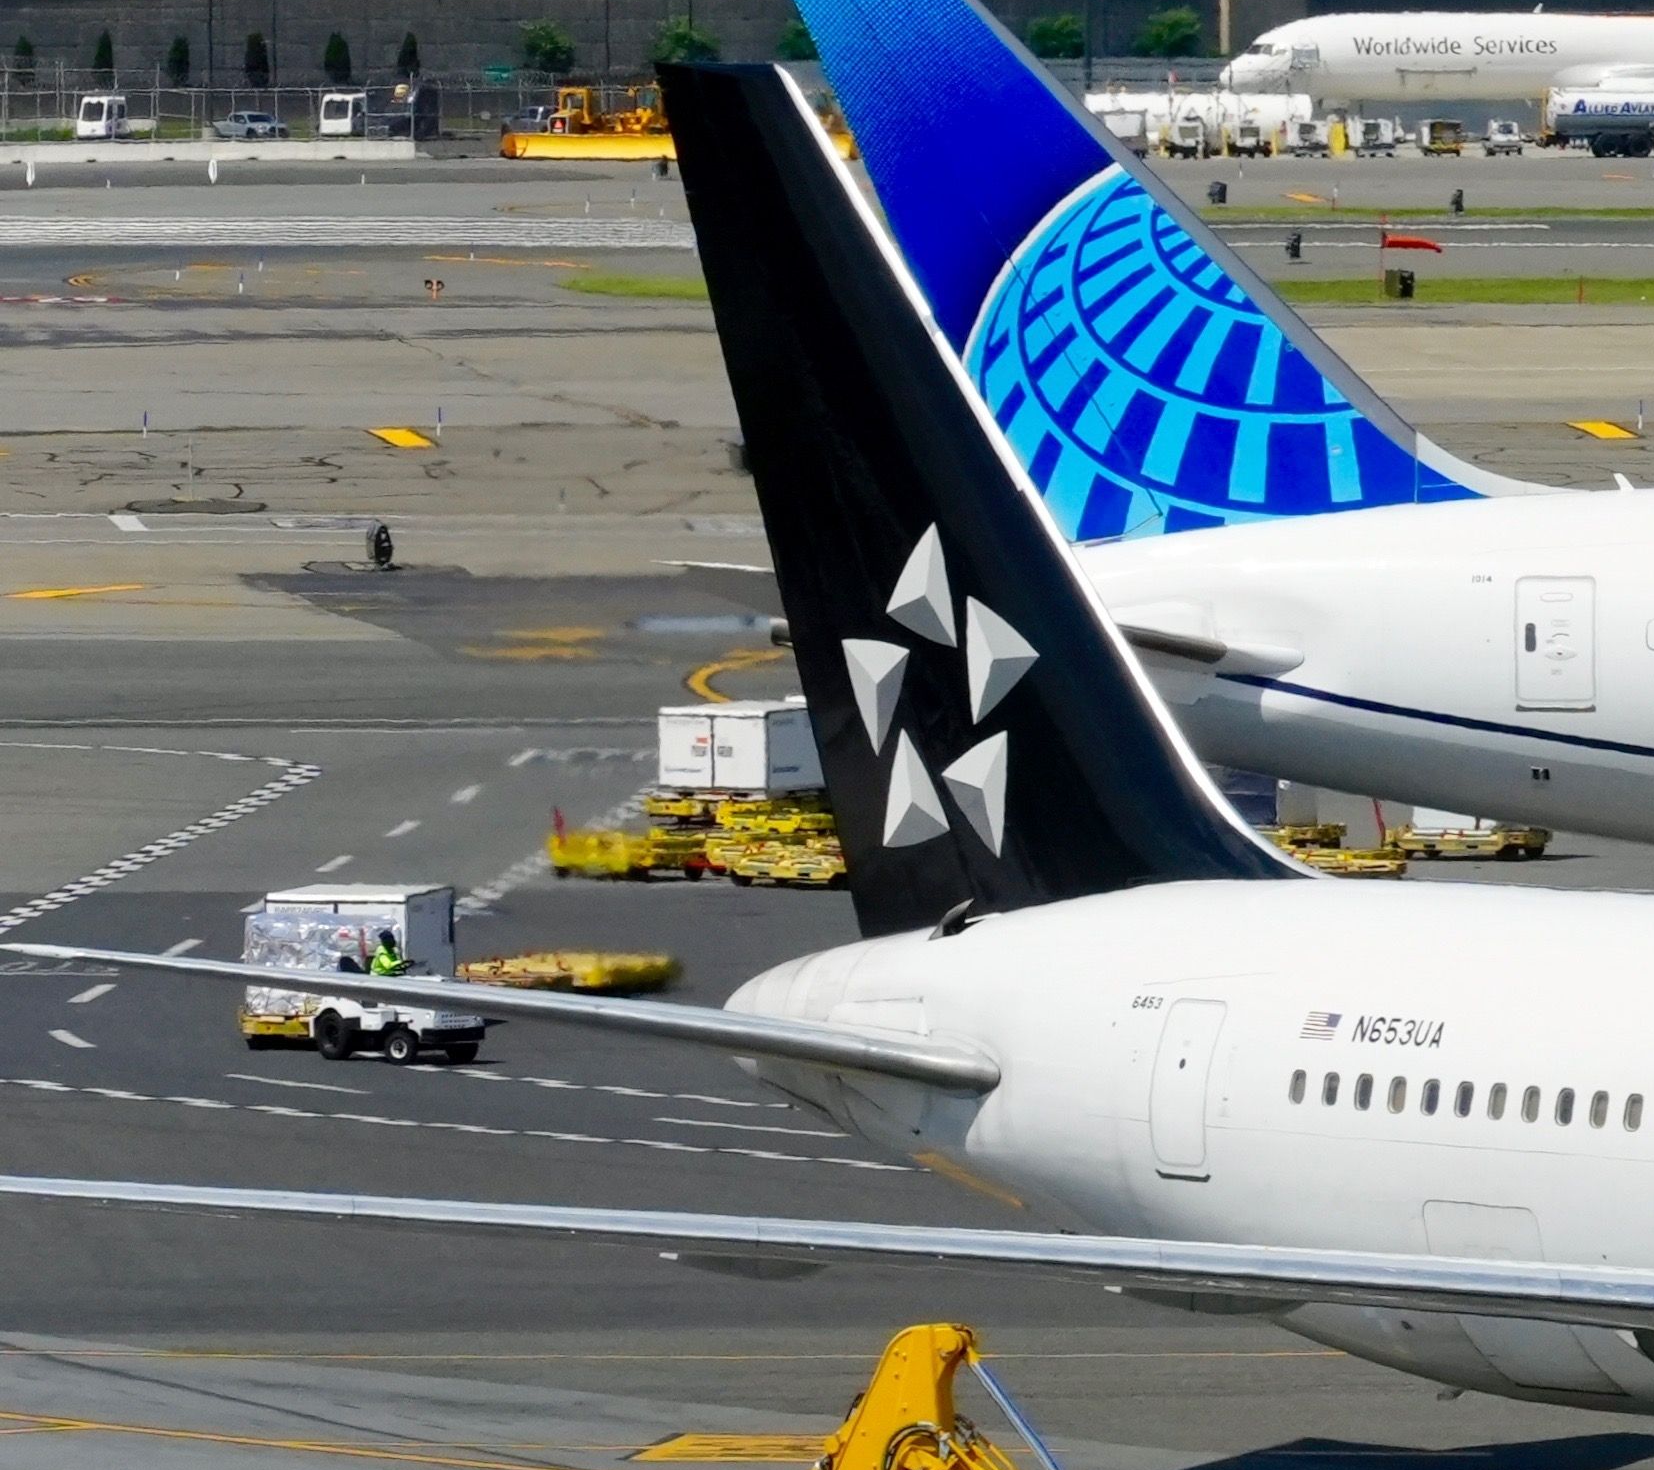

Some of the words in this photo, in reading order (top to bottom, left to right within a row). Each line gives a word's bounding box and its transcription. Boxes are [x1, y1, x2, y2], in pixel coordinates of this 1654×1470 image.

[1353, 36, 1462, 56] Worldwide
[1474, 35, 1558, 56] Services
[1573, 99, 1618, 114] ALLIED
[1132, 996, 1163, 1010] 6453
[1352, 1016, 1444, 1049] N653UA
